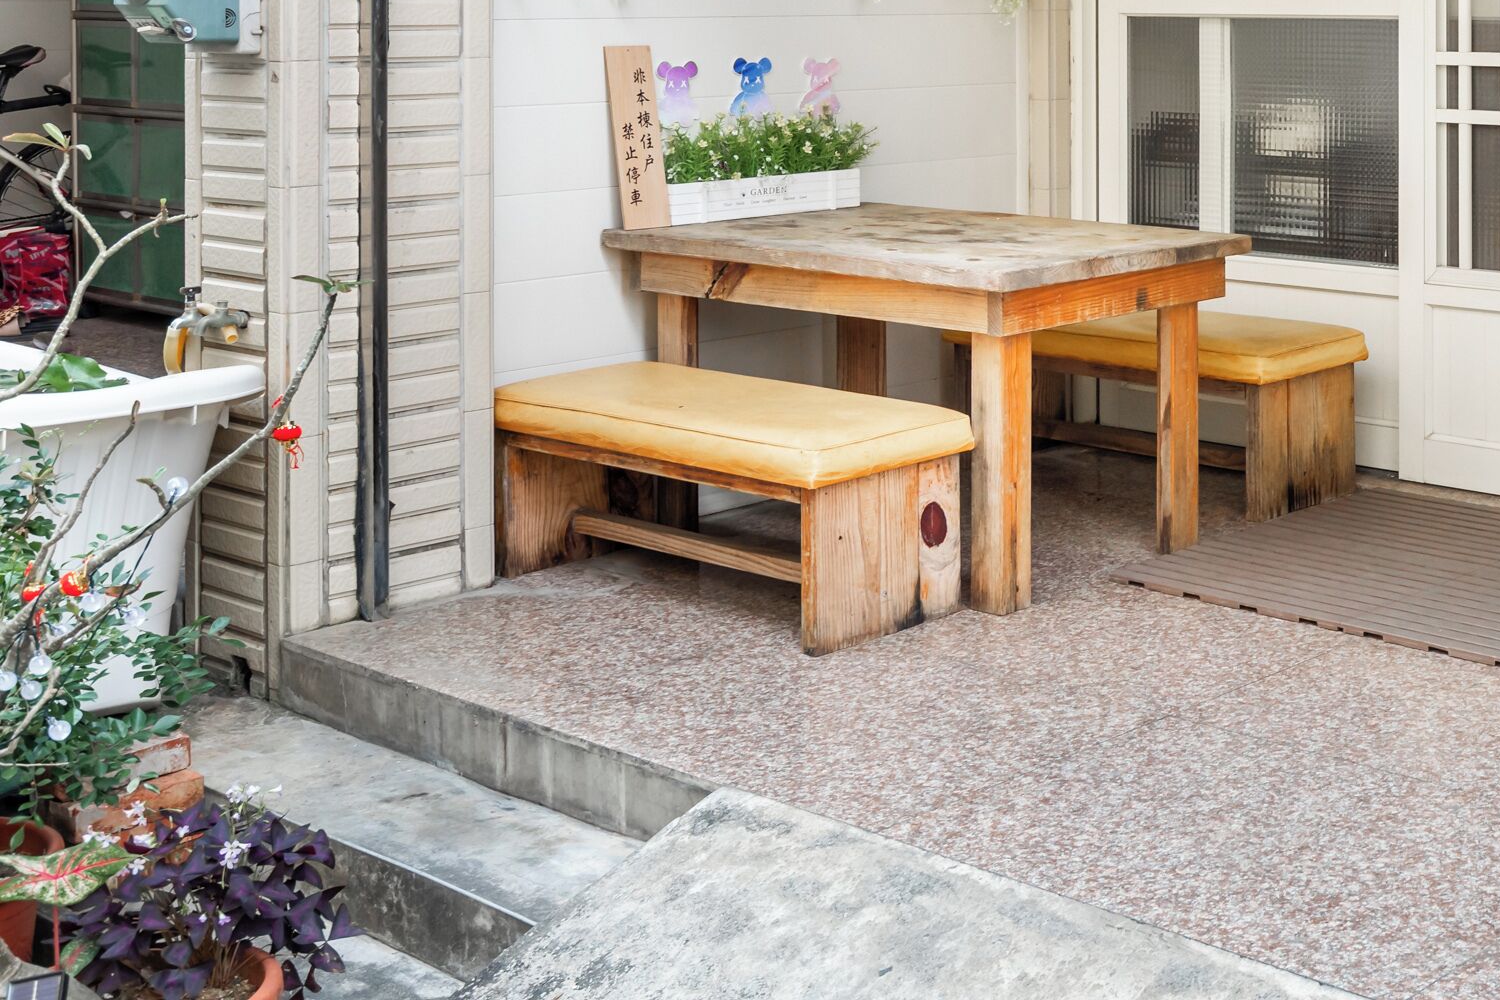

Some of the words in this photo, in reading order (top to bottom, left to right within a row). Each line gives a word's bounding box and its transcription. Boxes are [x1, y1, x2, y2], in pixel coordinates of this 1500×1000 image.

[633, 67, 656, 173] 非本棟住戶
[621, 121, 644, 207] 禁止停車
[750, 185, 787, 197] GARDEN
